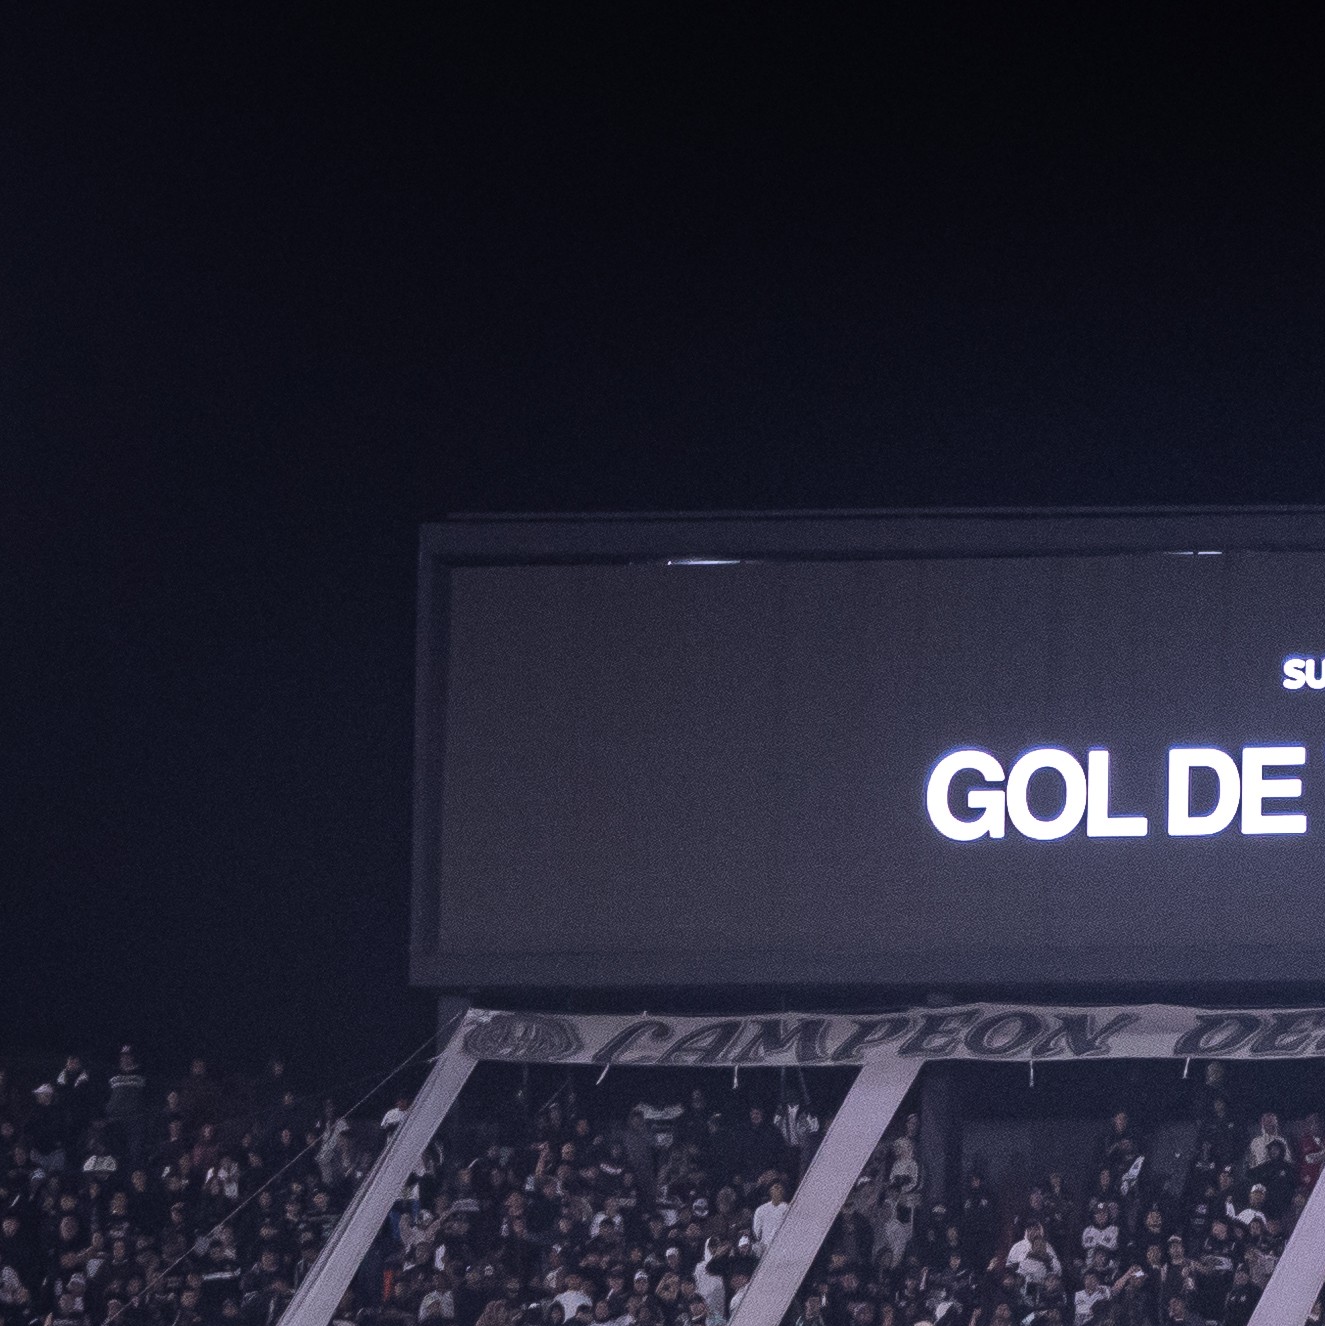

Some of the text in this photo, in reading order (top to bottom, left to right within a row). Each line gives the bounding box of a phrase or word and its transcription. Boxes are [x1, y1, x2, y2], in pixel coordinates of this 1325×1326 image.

[927, 746, 1148, 842] GOL
[1167, 745, 1307, 837] DE
[592, 1005, 1136, 1064] CAMPEON
